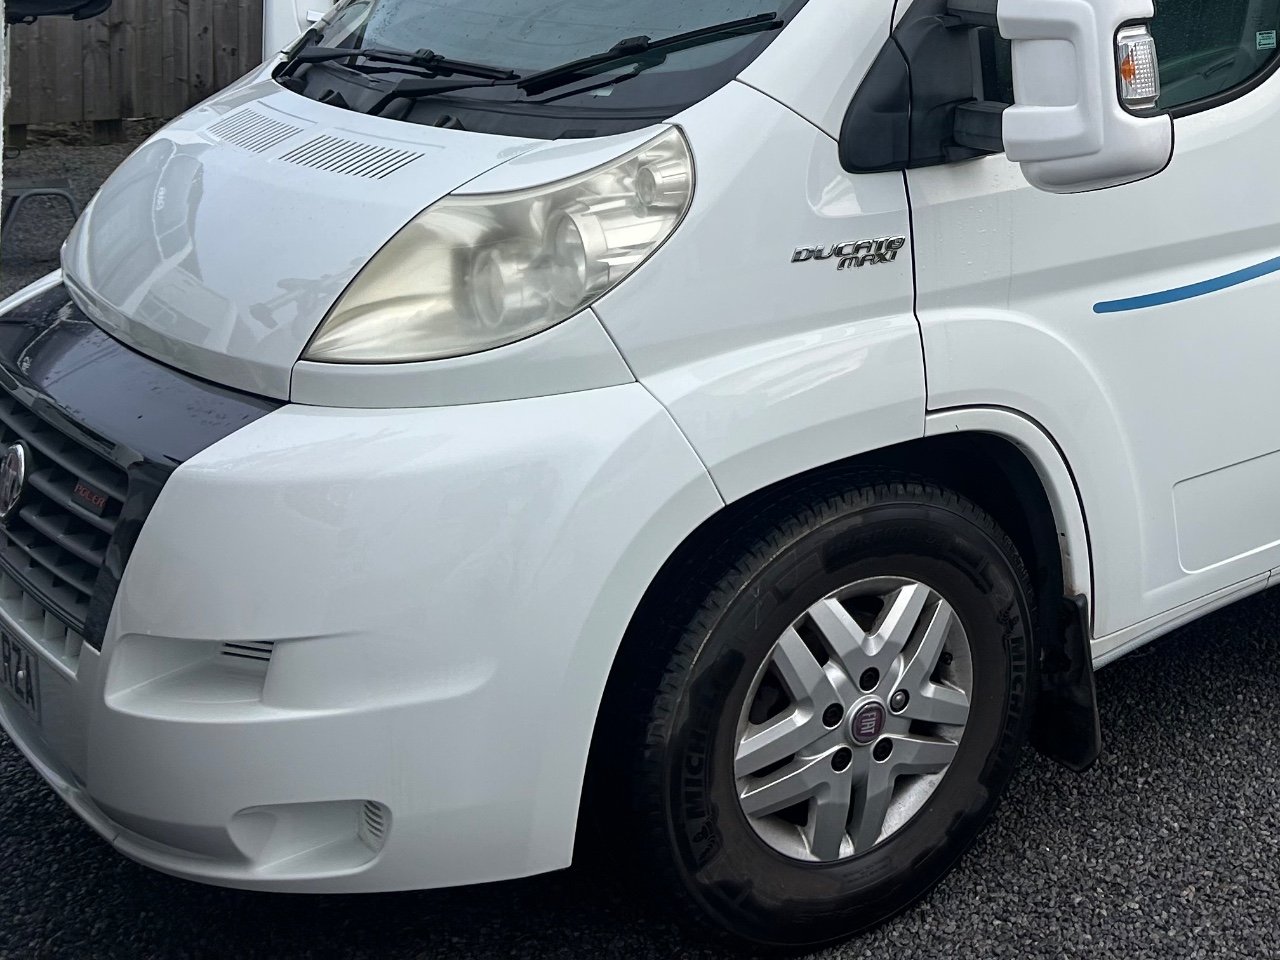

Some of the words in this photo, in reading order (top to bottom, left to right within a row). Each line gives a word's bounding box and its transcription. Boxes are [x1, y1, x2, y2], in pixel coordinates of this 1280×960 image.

[791, 235, 904, 263] DUCATO
[837, 250, 898, 270] MAXI
[860, 711, 877, 734] FIAT
